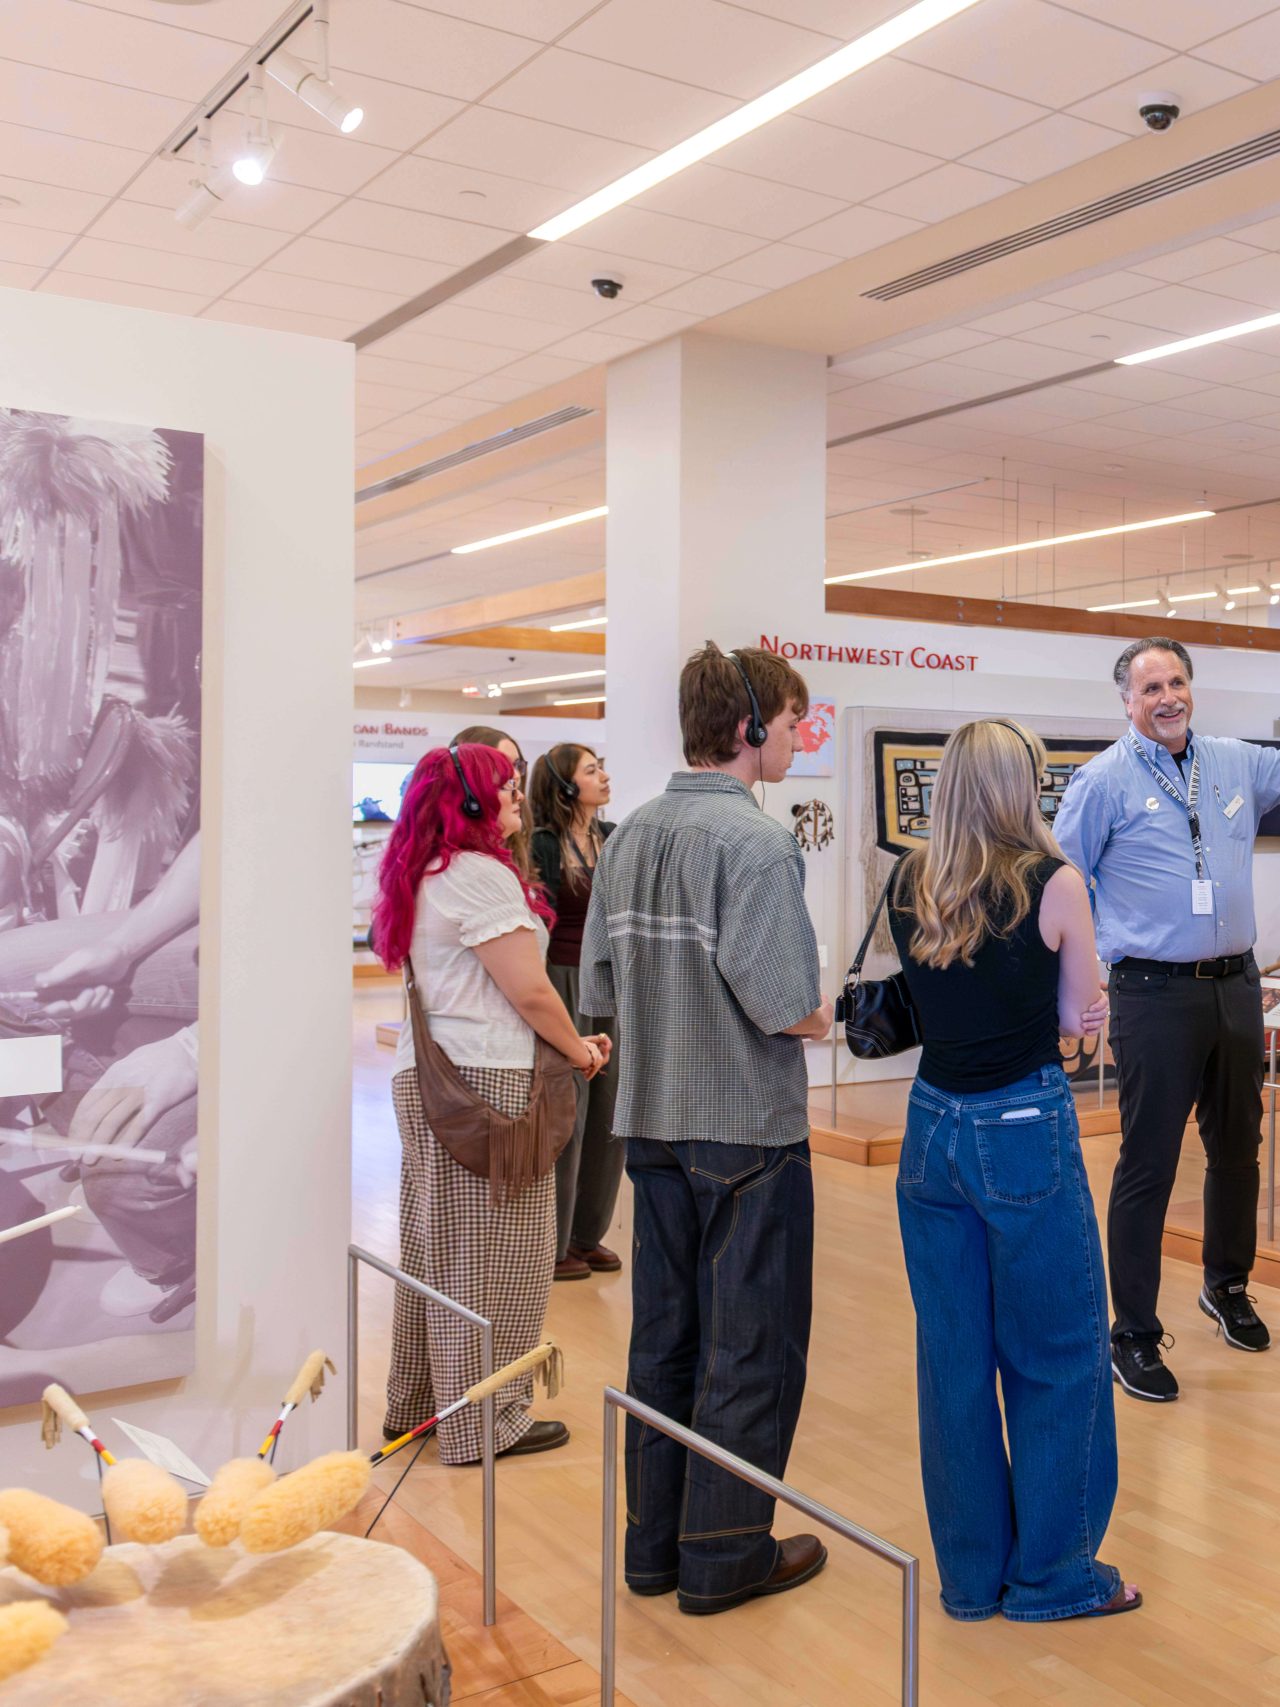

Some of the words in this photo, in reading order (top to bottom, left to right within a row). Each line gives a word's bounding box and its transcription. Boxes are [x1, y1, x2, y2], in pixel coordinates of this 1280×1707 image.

[760, 634, 904, 666] NORTHWEST
[910, 647, 979, 671] COAST
[384, 722, 429, 737] BANDS
